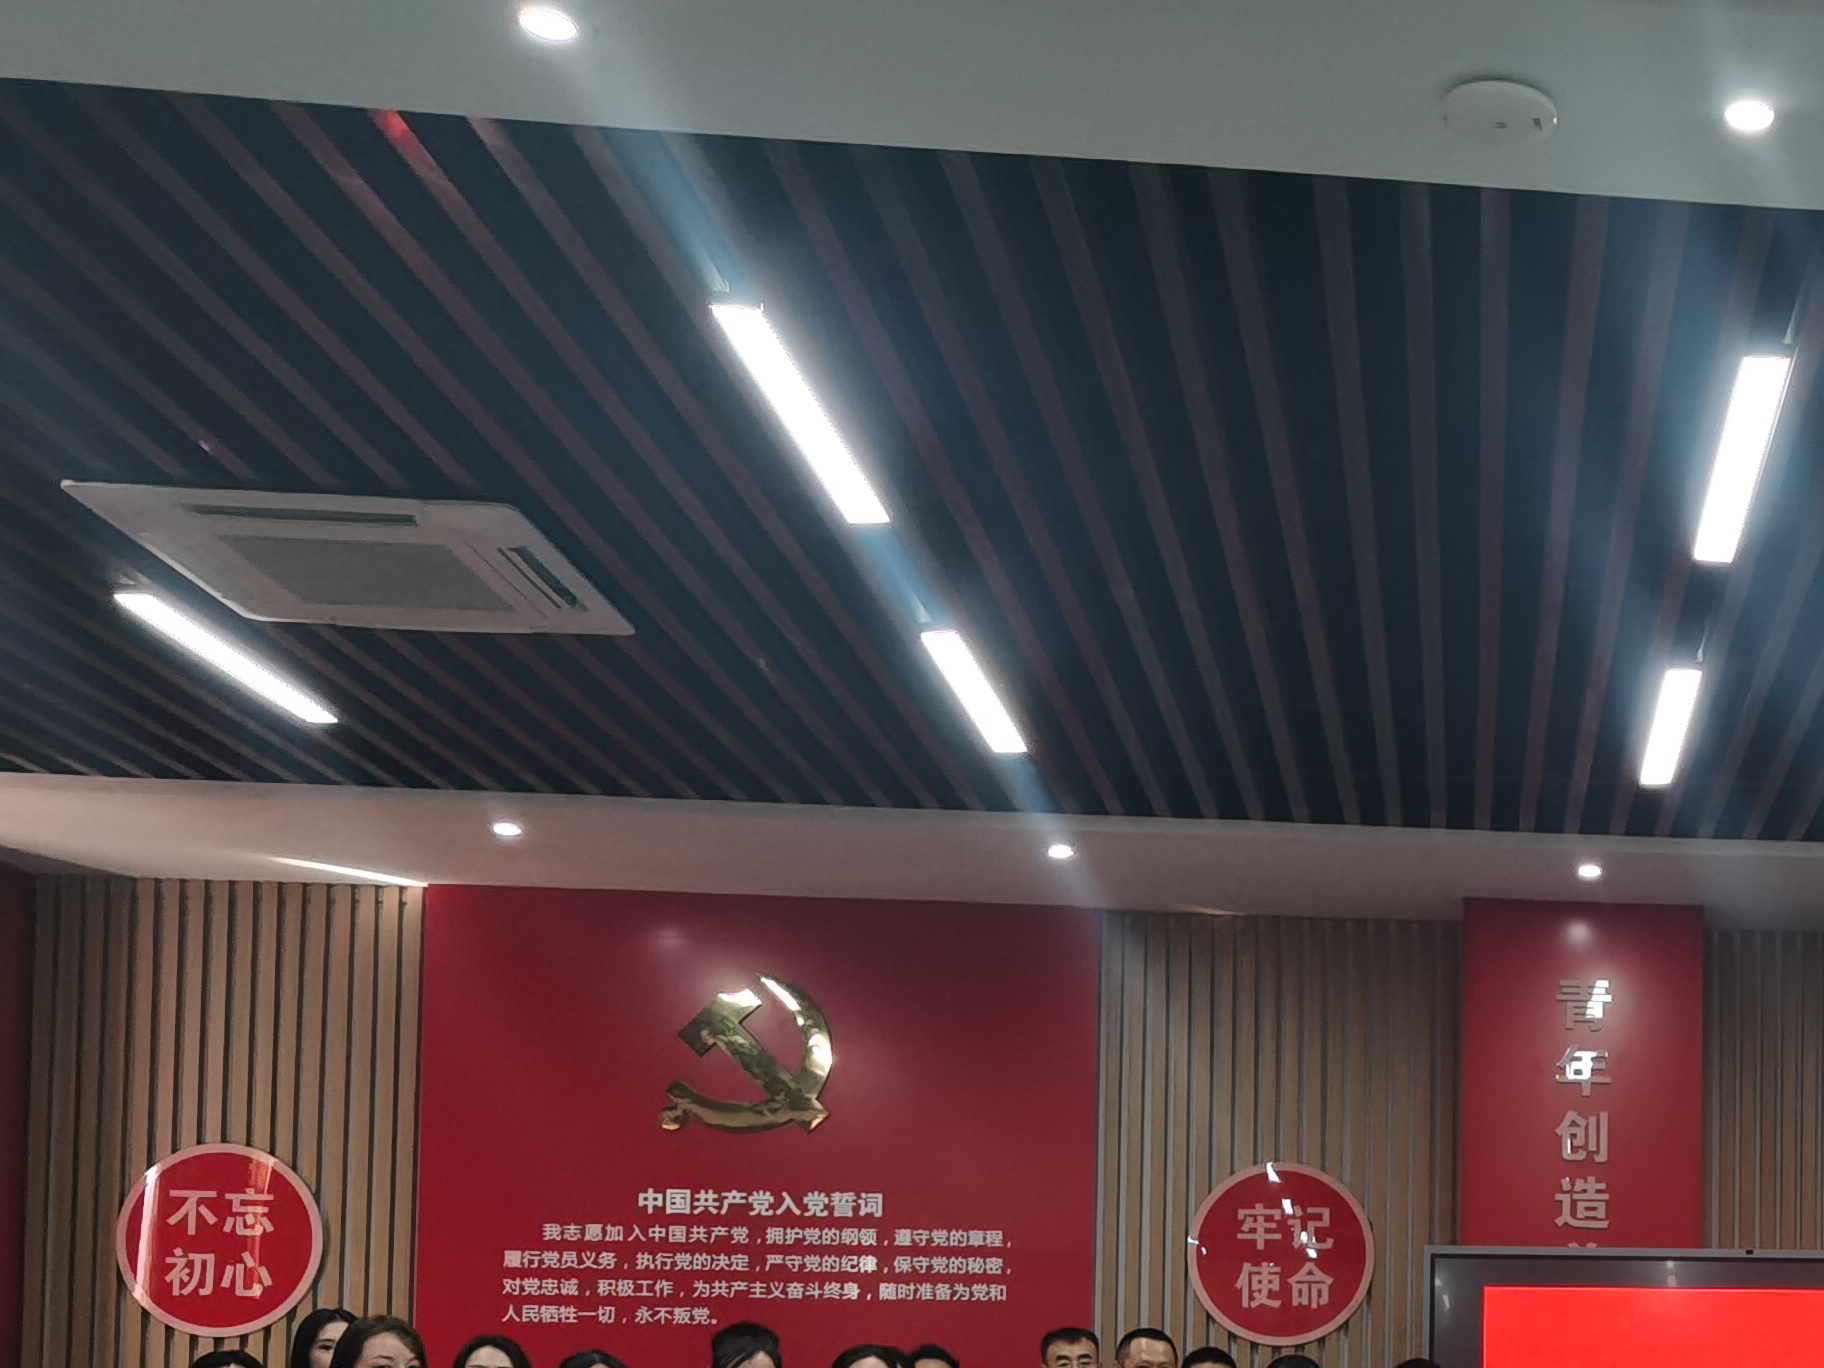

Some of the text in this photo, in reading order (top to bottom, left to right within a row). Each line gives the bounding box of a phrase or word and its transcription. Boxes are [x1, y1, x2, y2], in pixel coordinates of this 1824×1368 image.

[1554, 978, 1613, 1247] 青年创造
[166, 1188, 274, 1236] 不忘
[638, 1188, 884, 1218] 中国共产党入党誓词
[1236, 1203, 1335, 1251] 牢记
[164, 1246, 273, 1300] 初心
[1235, 1261, 1334, 1309] 使命
